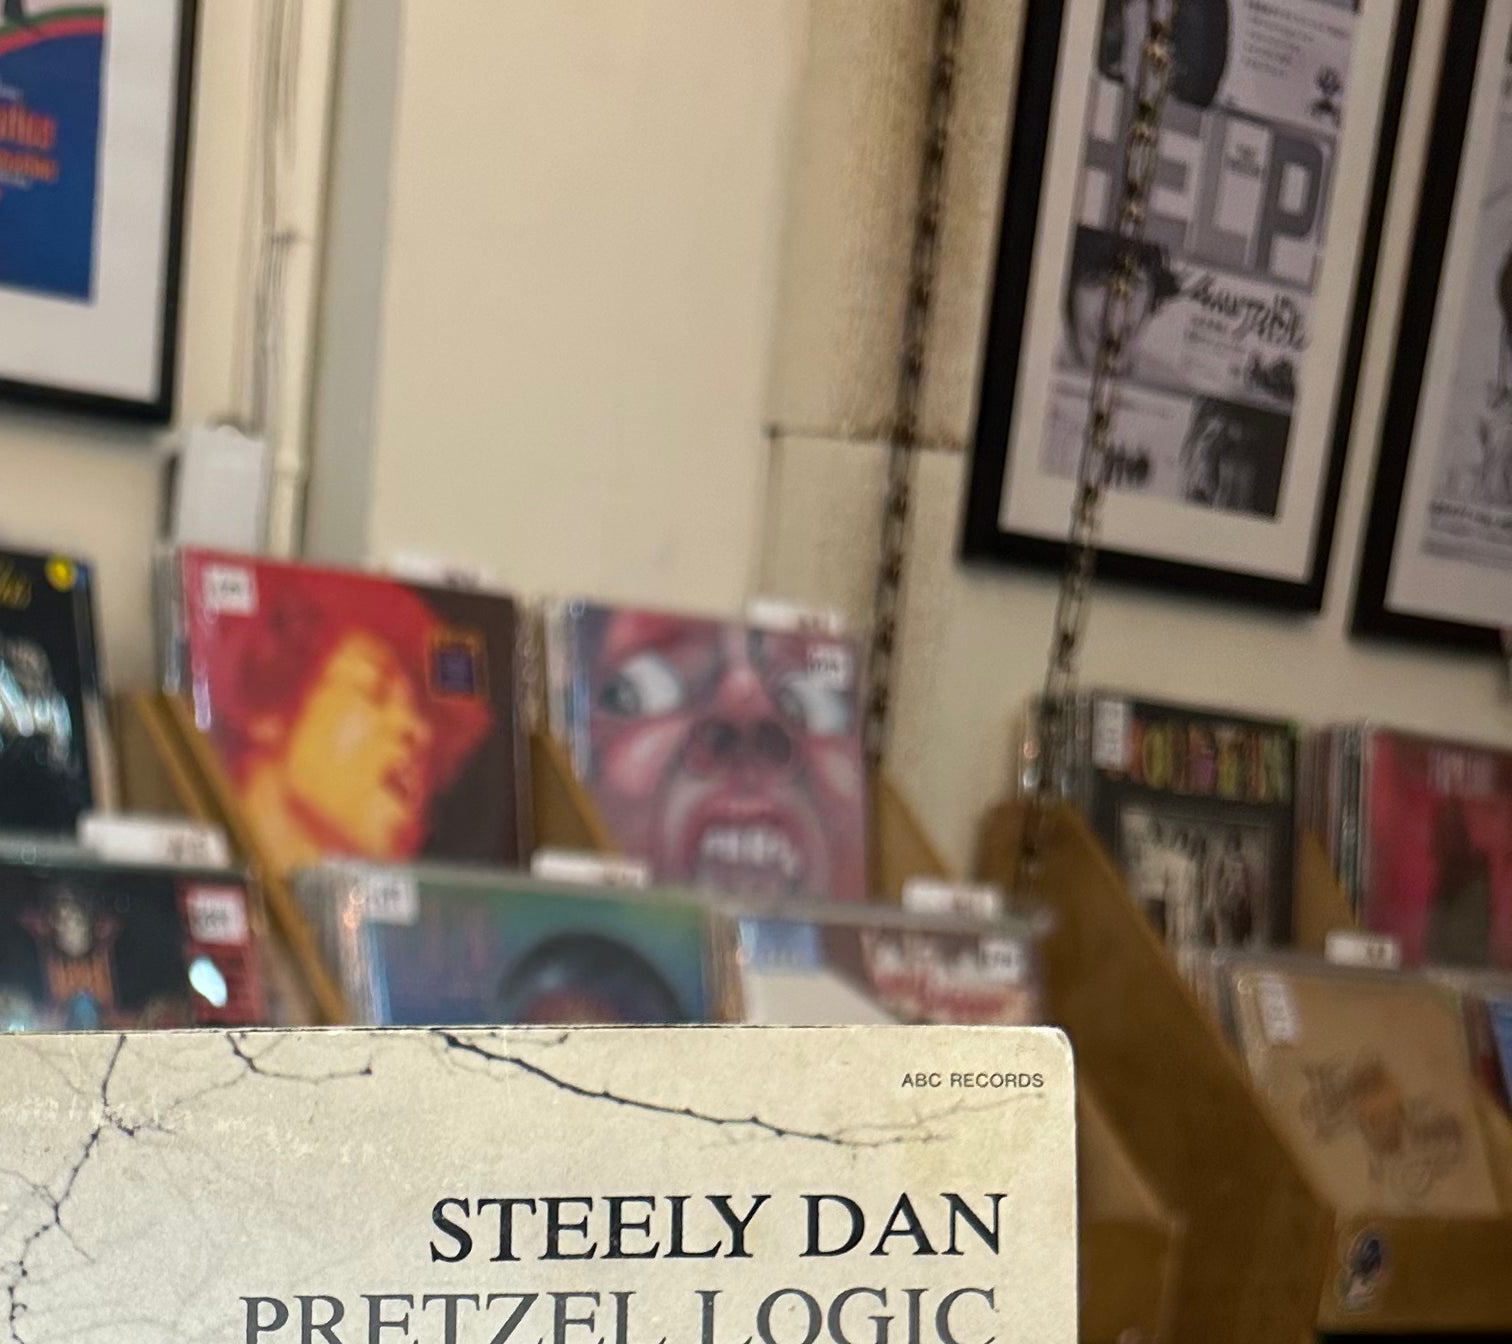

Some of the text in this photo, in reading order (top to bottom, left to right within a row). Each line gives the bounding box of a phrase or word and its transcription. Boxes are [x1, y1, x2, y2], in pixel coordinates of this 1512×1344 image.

[901, 1073, 1044, 1088] ABC RECORDS
[429, 1192, 1008, 1263] STEELY DAN
